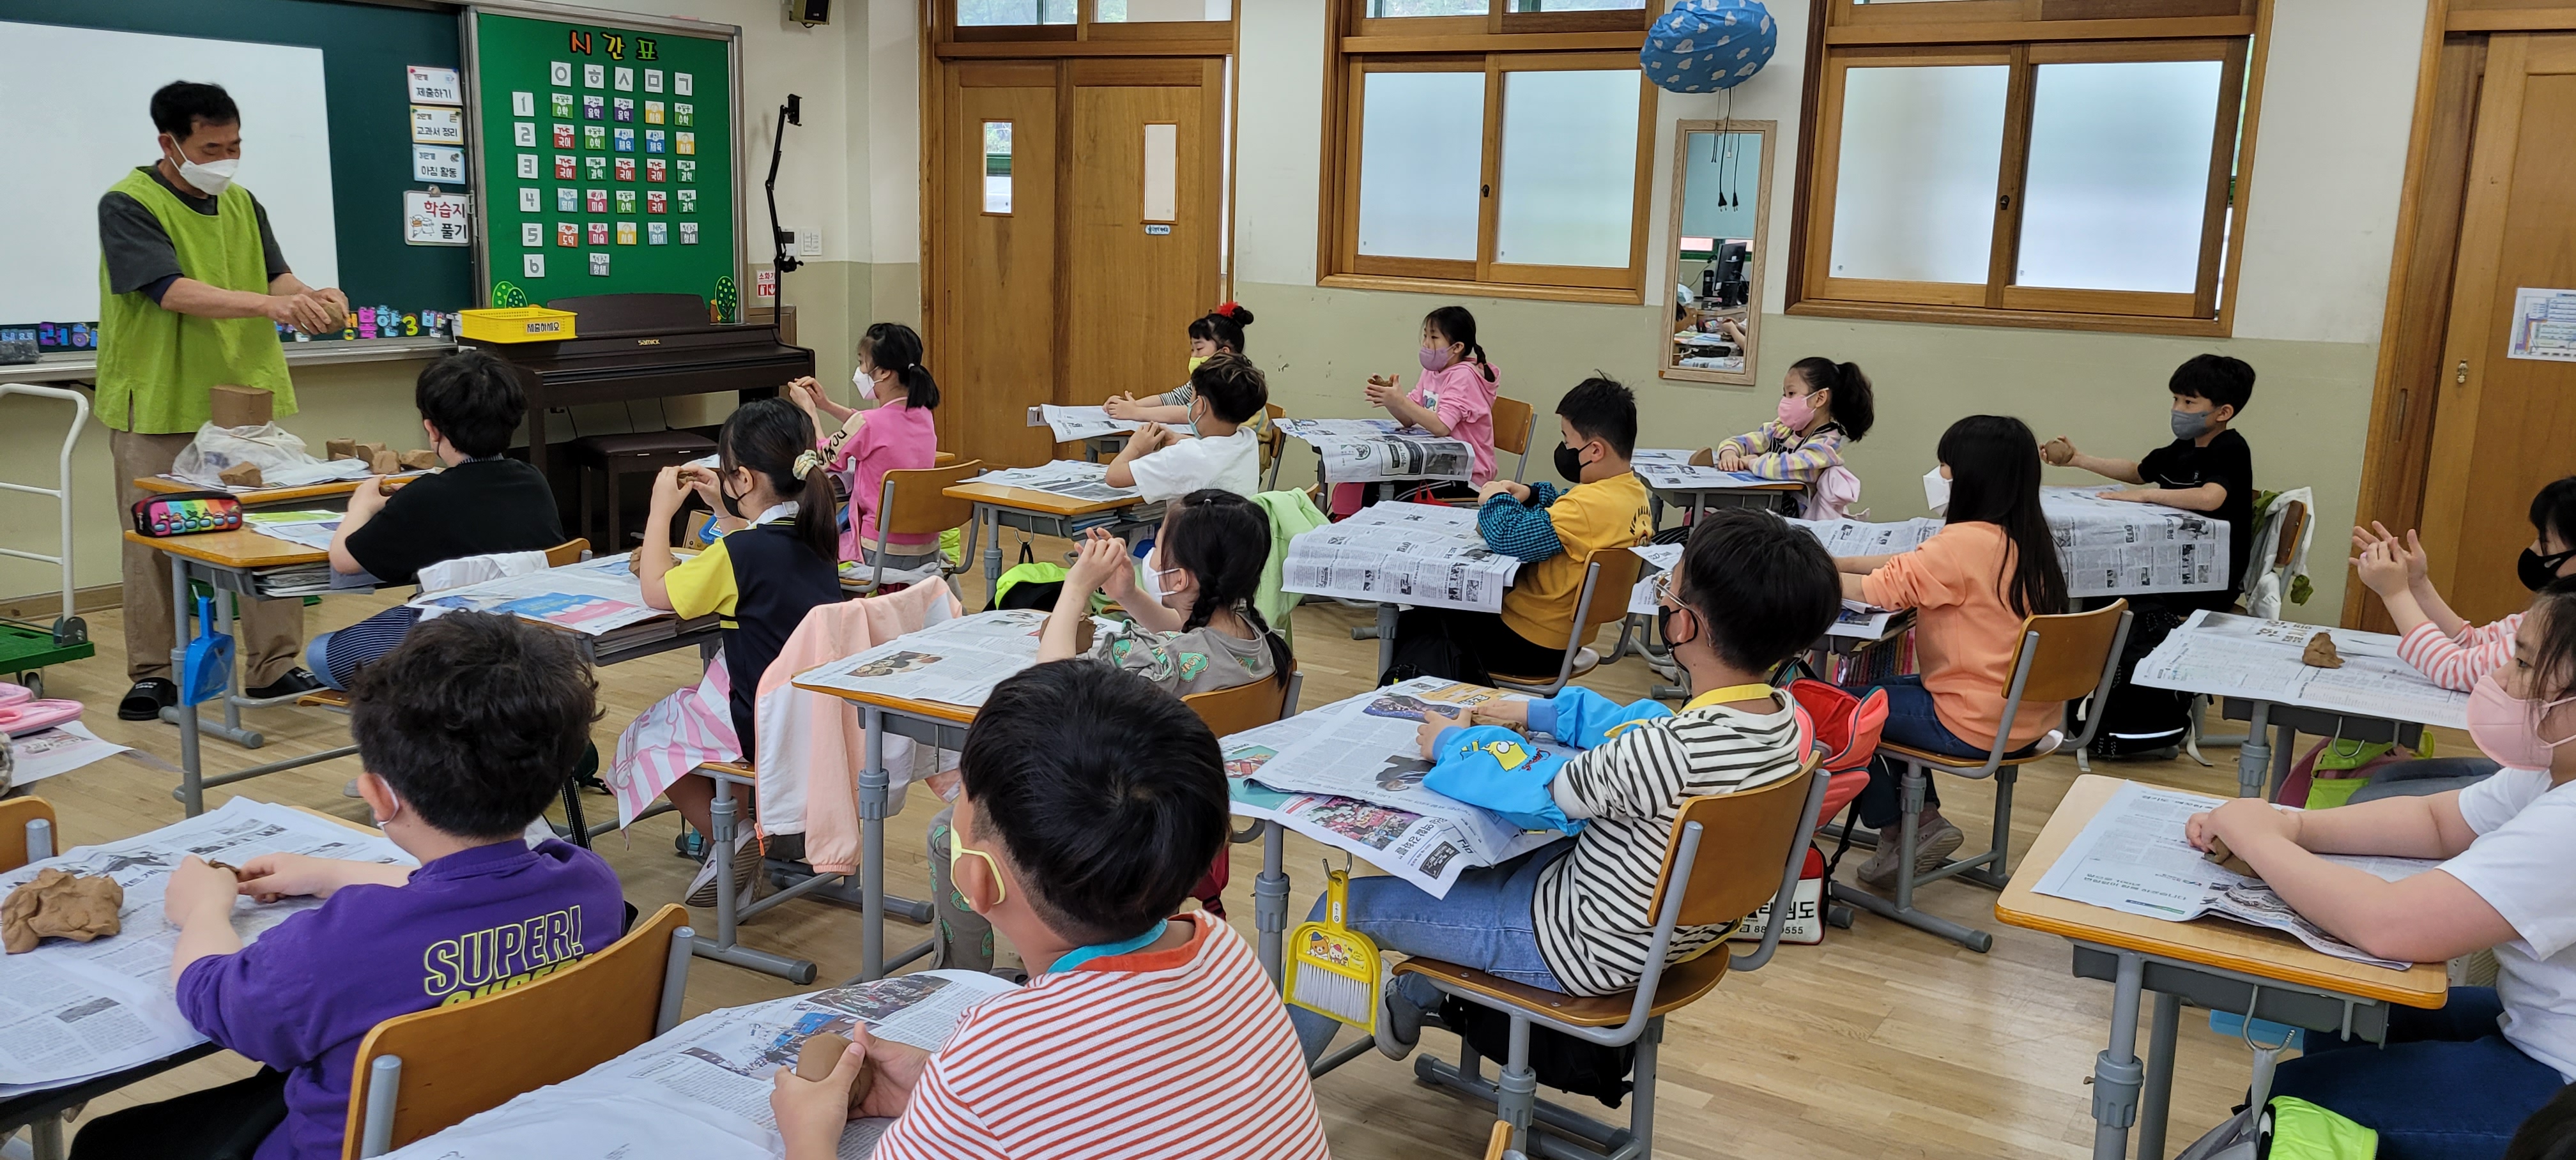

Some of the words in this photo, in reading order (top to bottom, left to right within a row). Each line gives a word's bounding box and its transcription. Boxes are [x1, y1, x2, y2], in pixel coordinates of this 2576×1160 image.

[416, 87, 452, 99] 제출하기
[521, 96, 526, 112] 1
[556, 108, 569, 117] 수학
[587, 108, 600, 118] 음악
[618, 109, 630, 121] 음악
[678, 114, 689, 125] 수학
[417, 126, 440, 137] 교과서
[442, 127, 458, 137] 정리
[521, 126, 531, 142] 2
[558, 137, 571, 147] 국어
[589, 138, 601, 148] 수학
[619, 140, 632, 151] 체육
[650, 141, 663, 152] 체육
[421, 165, 438, 177] 아침
[440, 166, 457, 179] 활동
[523, 158, 533, 174] 3
[560, 168, 572, 178] 국어
[591, 169, 604, 179] 과학
[620, 170, 632, 180] 국어
[650, 171, 663, 181] 국어
[681, 171, 693, 181] 과학
[424, 200, 466, 218] 학습지
[525, 192, 535, 208] 4
[562, 200, 574, 210] 영어
[592, 201, 604, 211] 미술
[620, 201, 632, 212] 수학
[651, 201, 663, 213] 국어
[682, 201, 694, 212] 과학
[441, 222, 467, 240] 풀기
[528, 227, 538, 243] 5
[562, 234, 574, 245] 도덕
[592, 234, 605, 244] 미술
[652, 233, 664, 244] 영어
[527, 322, 560, 333] 제출하세요
[424, 904, 585, 996] SUPER!
